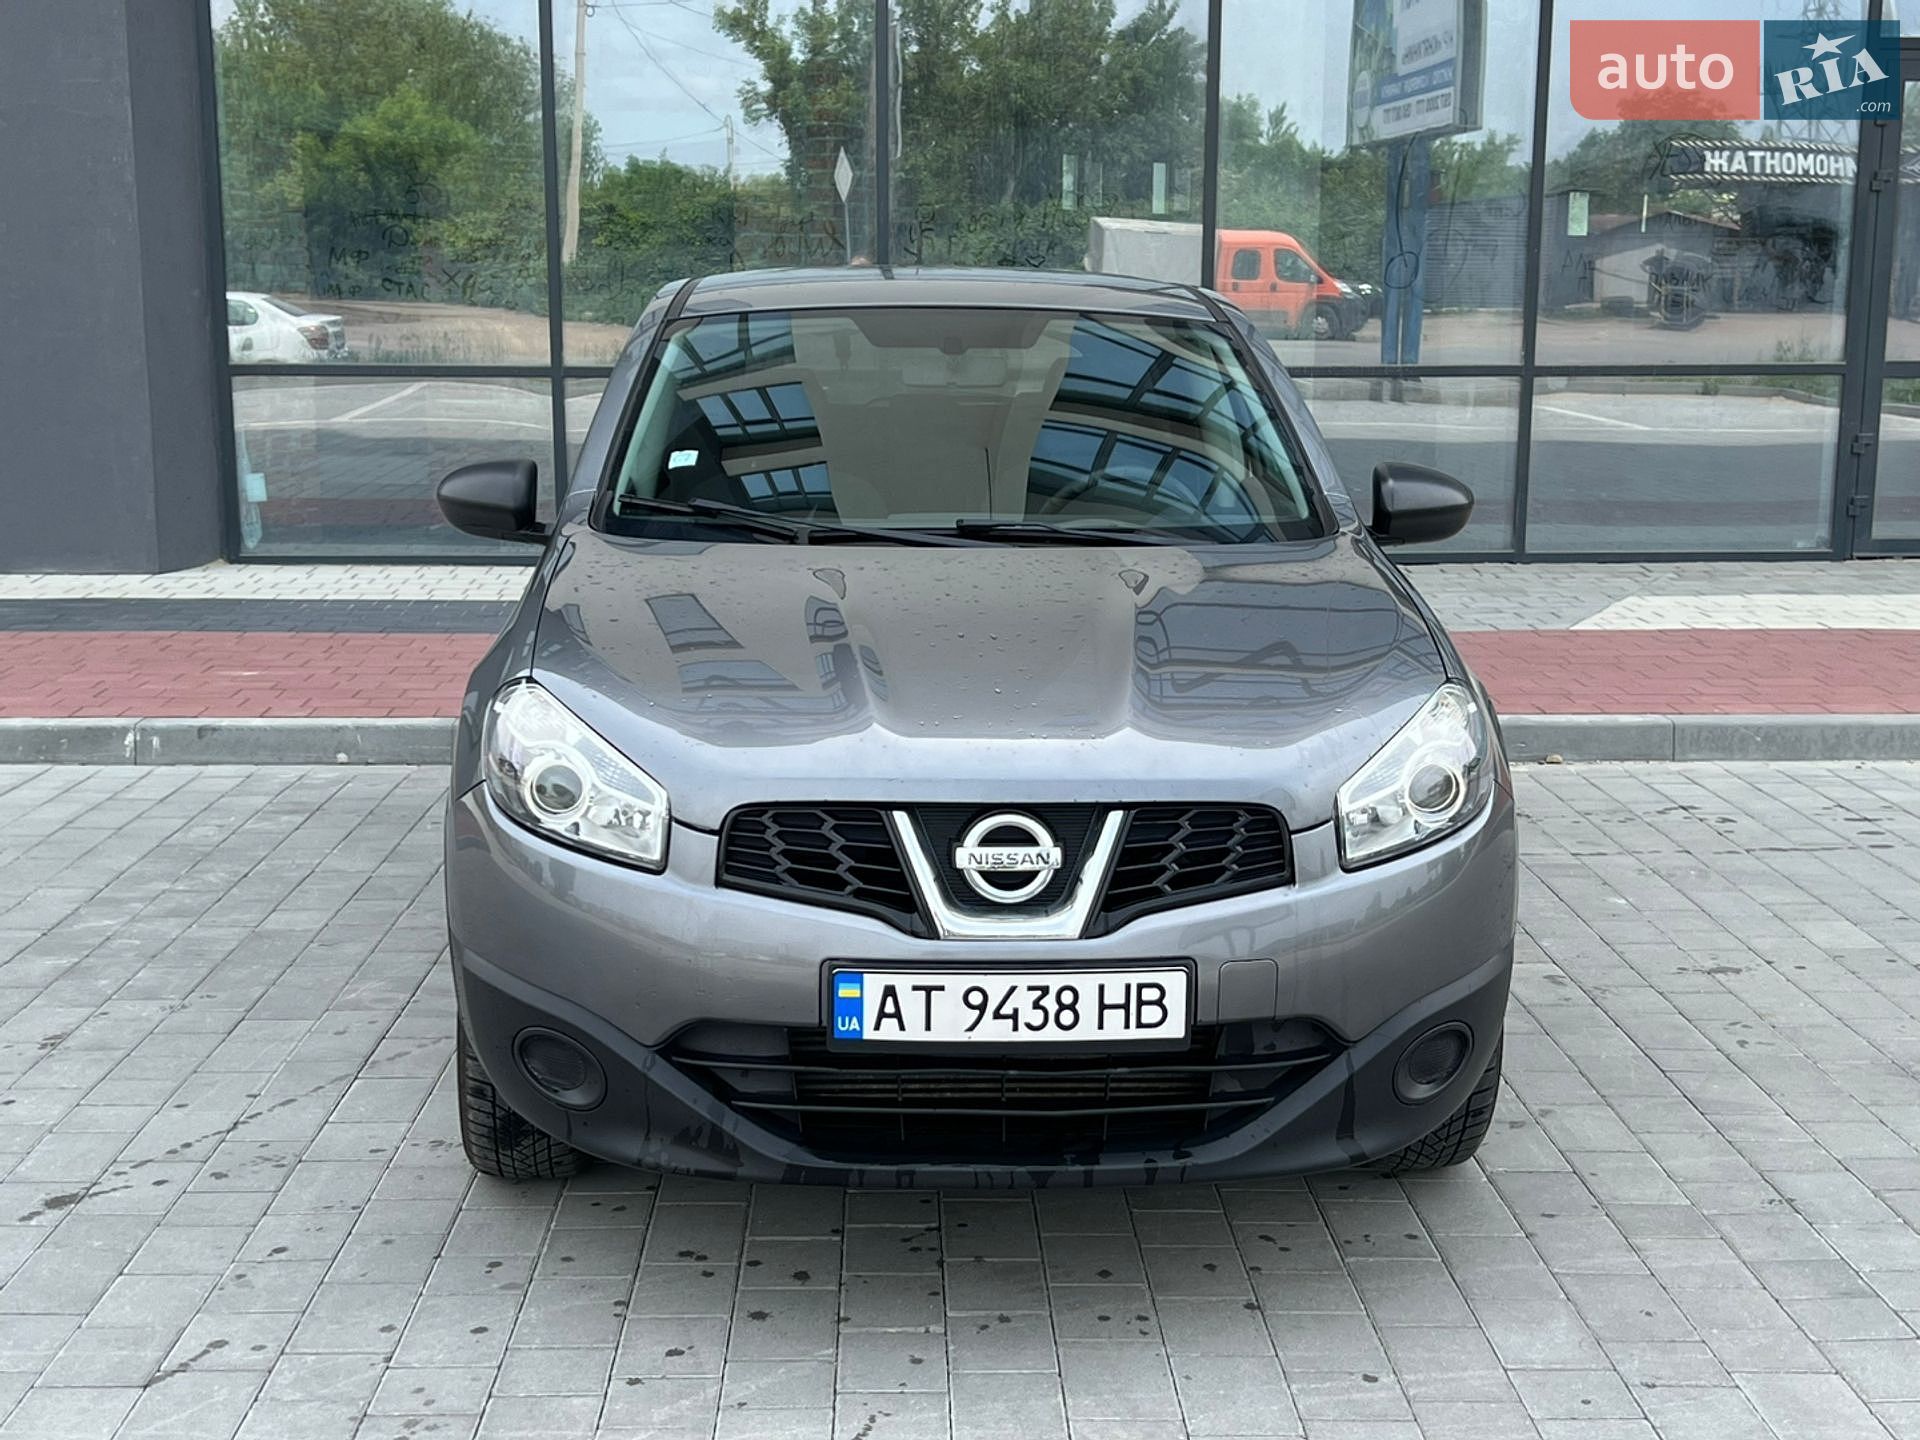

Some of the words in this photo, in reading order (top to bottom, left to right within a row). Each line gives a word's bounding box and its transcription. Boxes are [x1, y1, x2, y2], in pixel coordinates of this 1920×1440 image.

[968, 852, 1050, 866] NISSAN
[873, 984, 945, 1032] AT
[962, 985, 1080, 1032] 9438
[1097, 982, 1168, 1031] HB
[838, 1016, 860, 1031] UA
